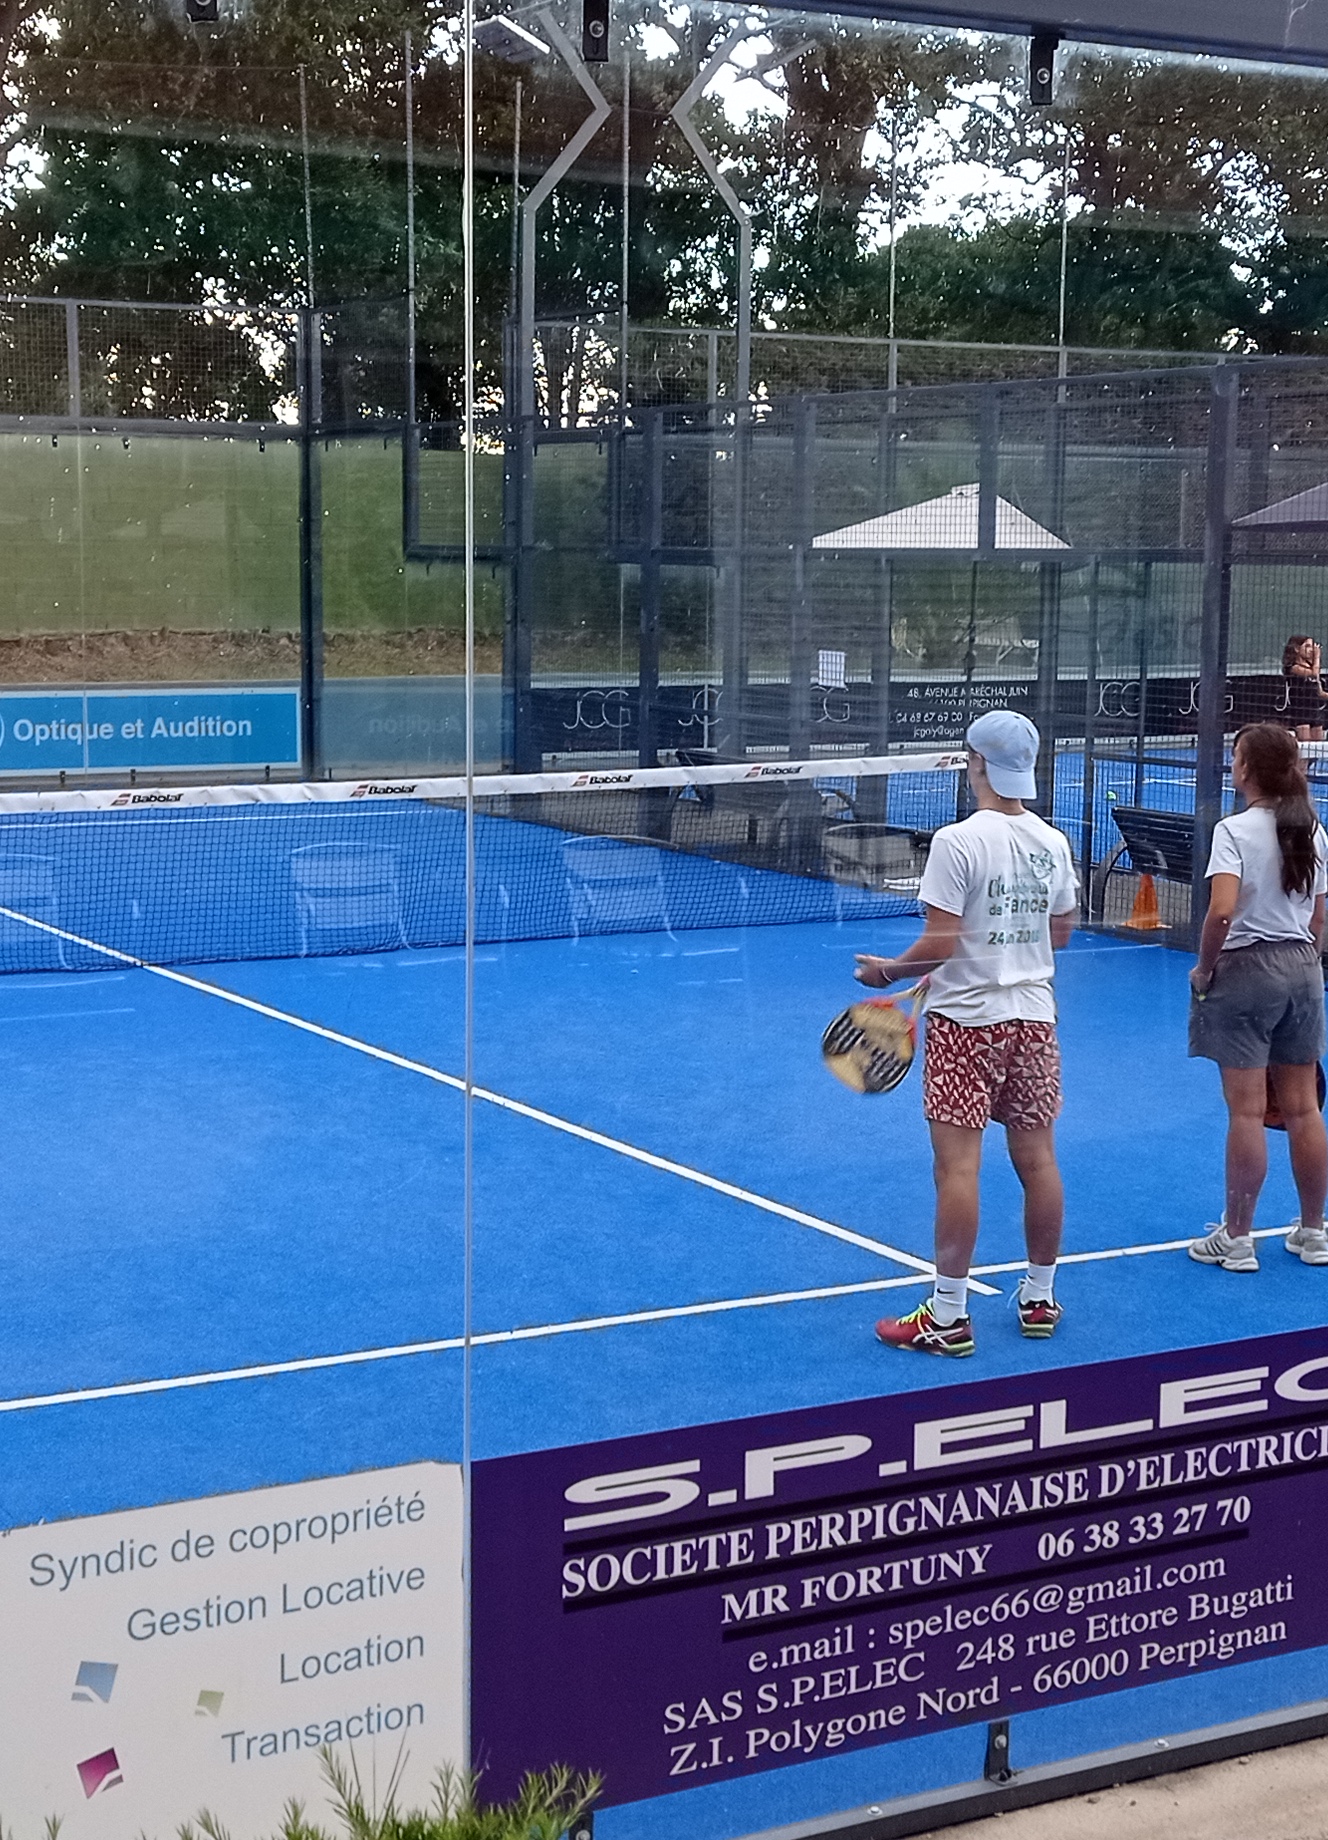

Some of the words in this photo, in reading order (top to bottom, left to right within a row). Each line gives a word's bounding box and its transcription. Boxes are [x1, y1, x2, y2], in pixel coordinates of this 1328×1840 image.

[13, 718, 114, 746] Optique
[121, 718, 144, 739] et
[151, 716, 252, 738] Audition
[563, 690, 631, 728] JCG
[131, 792, 184, 804] Babolat
[368, 784, 418, 796] Babolat
[589, 774, 633, 785] Babolat
[29, 1538, 159, 1591] Syndic
[170, 1528, 216, 1563] de
[228, 1490, 425, 1554] copropriété
[562, 1526, 755, 1600] SOCIETE
[765, 1466, 1090, 1561] PERPIGNANAISE
[721, 1584, 790, 1625] MR
[801, 1544, 993, 1608] FORTUNY
[1037, 1528, 1075, 1562] 06
[1083, 1520, 1120, 1553] 38
[1128, 1513, 1164, 1545] 33
[1173, 1504, 1208, 1536] 27
[1217, 1495, 1252, 1526] 70
[127, 1593, 268, 1642] Gestion
[282, 1565, 426, 1614] Locative
[748, 1624, 855, 1673] e.mail
[889, 1556, 1227, 1650] spelec66@gmail.com
[279, 1634, 425, 1685] Location
[663, 1690, 743, 1735] SAS
[756, 1651, 925, 1714] S.P.ELEC
[956, 1633, 1016, 1672] 248
[1026, 1627, 1076, 1657] rue
[1086, 1606, 1179, 1643] Ettore
[1188, 1574, 1295, 1622] Bugatti
[669, 1736, 734, 1776] Z.I.
[745, 1705, 907, 1759] Polygone
[917, 1676, 999, 1721] Nord
[1033, 1649, 1129, 1693] 66000
[1139, 1620, 1288, 1672] Perpignan
[221, 1702, 425, 1764] Transaction
